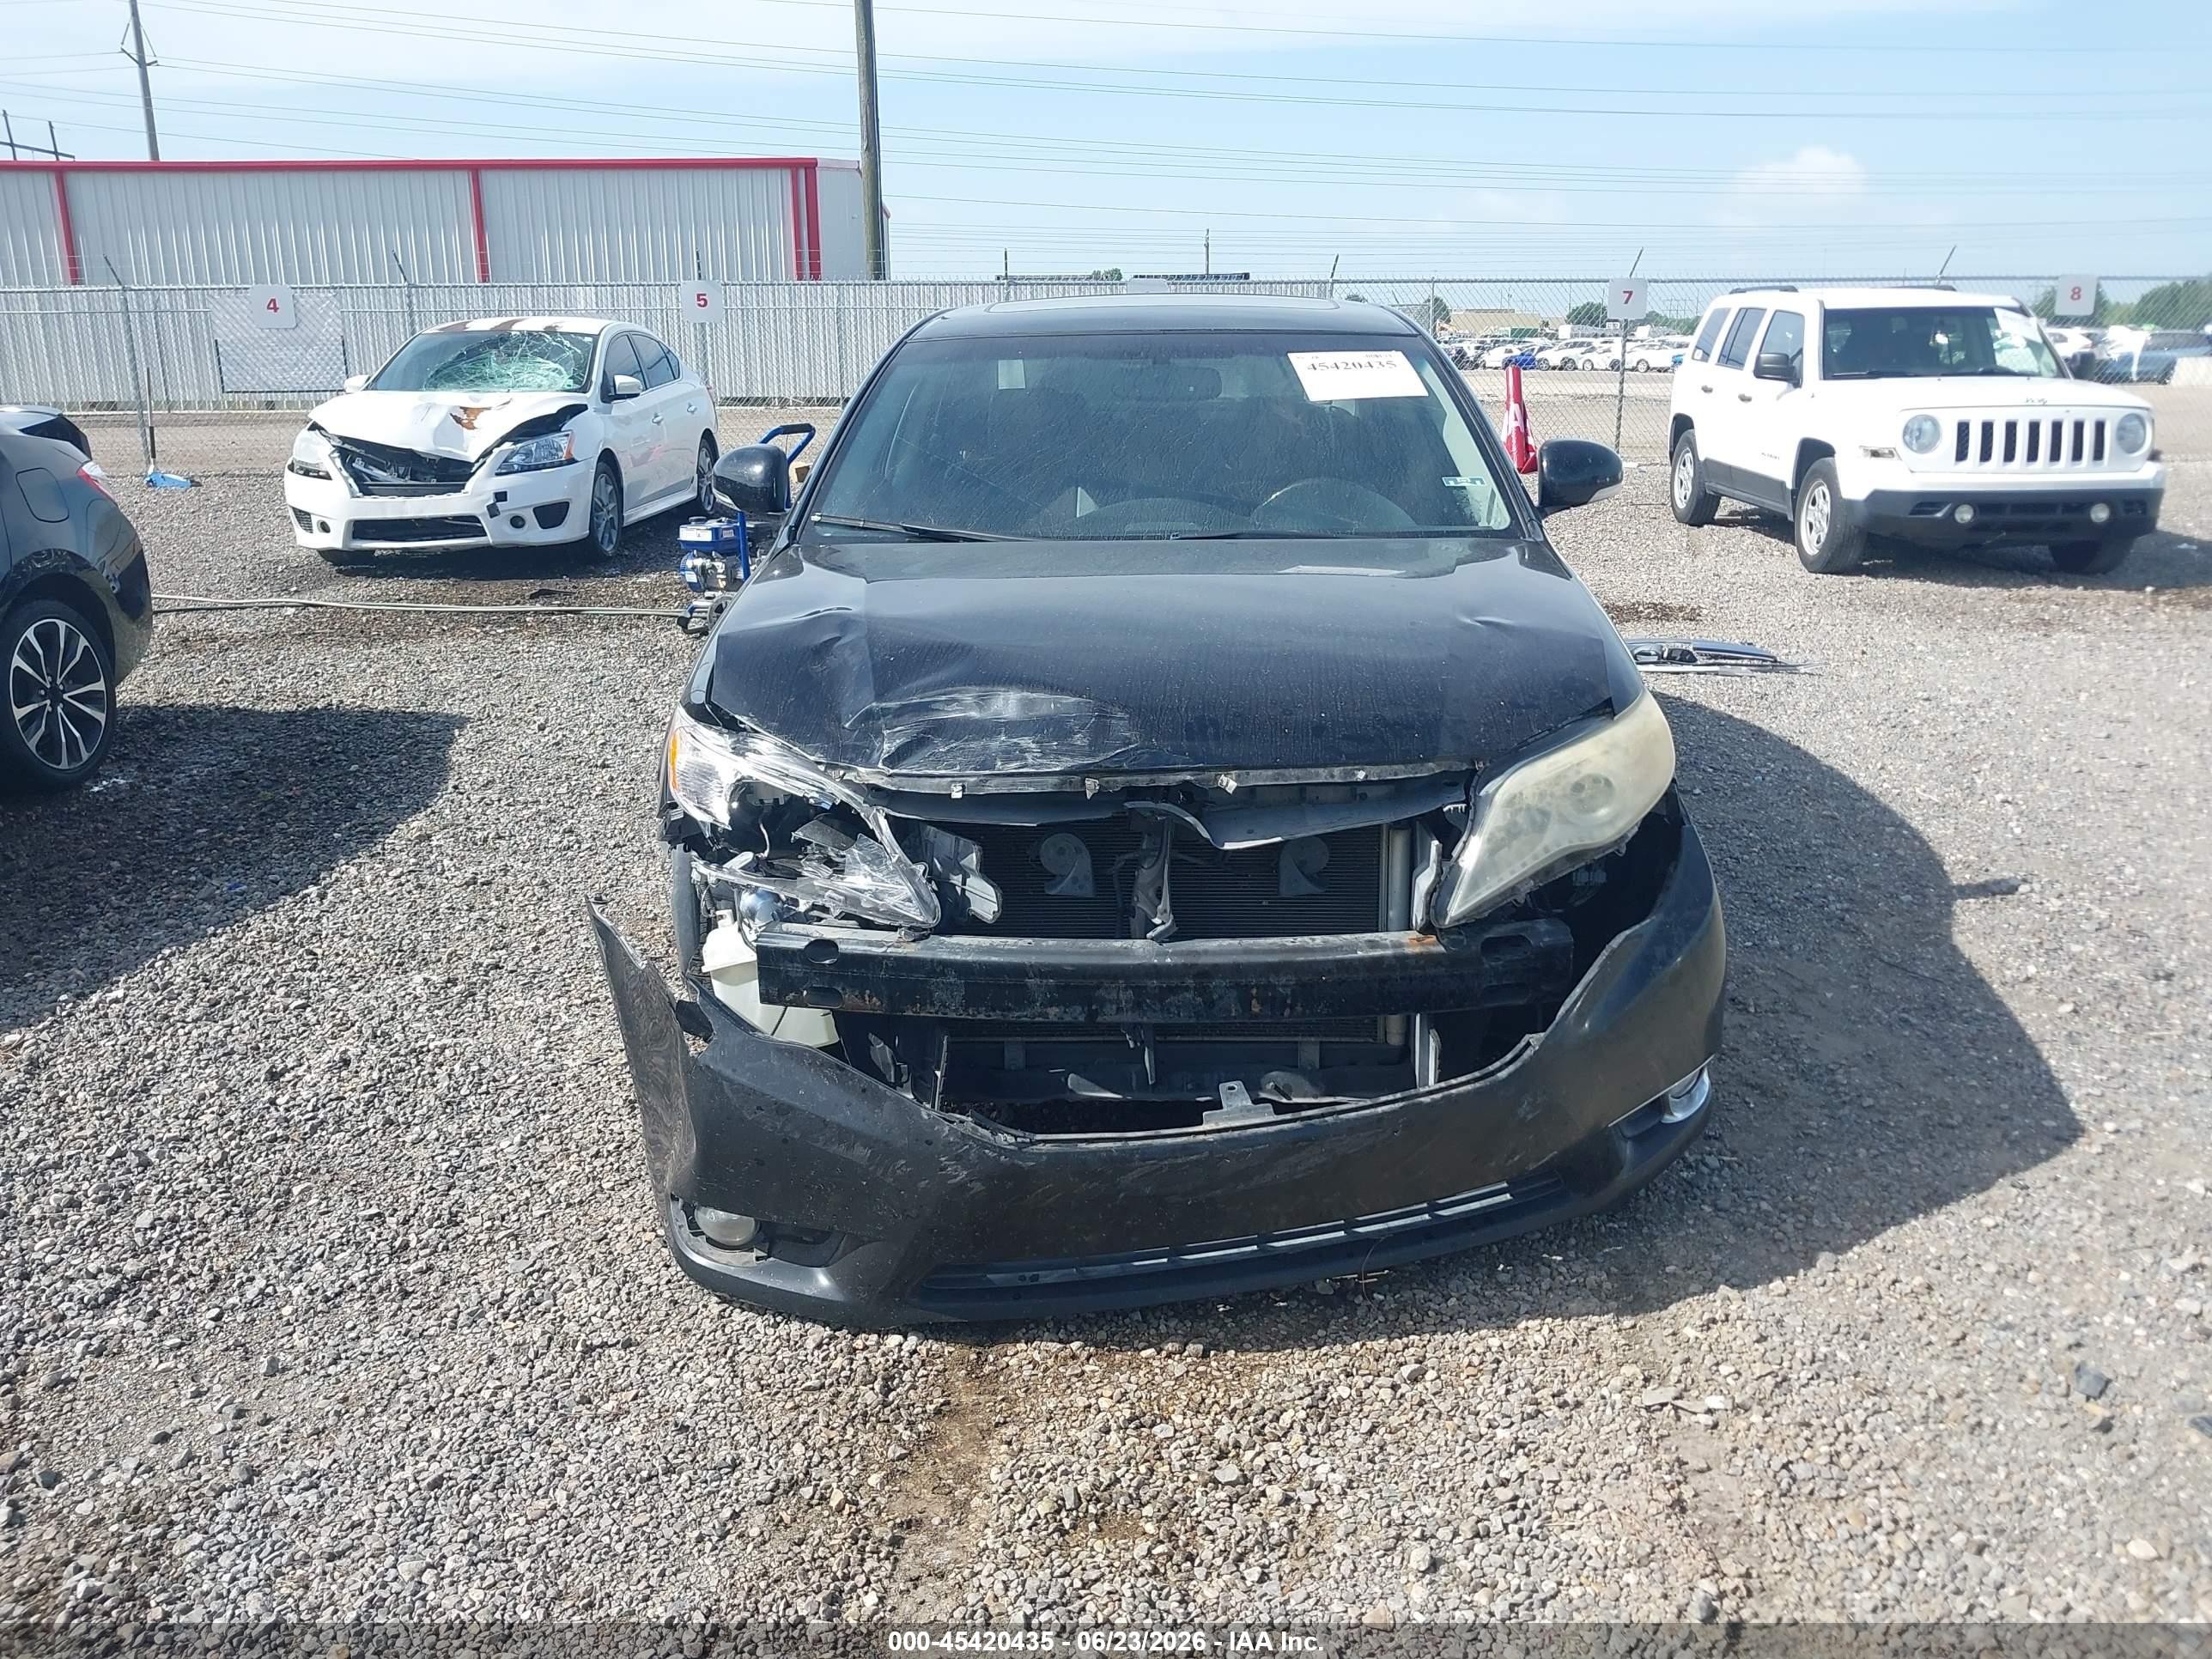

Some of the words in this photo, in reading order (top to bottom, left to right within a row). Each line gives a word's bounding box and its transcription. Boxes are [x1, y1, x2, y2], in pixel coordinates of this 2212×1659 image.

[696, 293, 708, 308] 5
[1622, 290, 1634, 305] 7
[2069, 286, 2082, 301] 8
[266, 297, 280, 313] 4
[1306, 360, 1398, 371] 45420435
